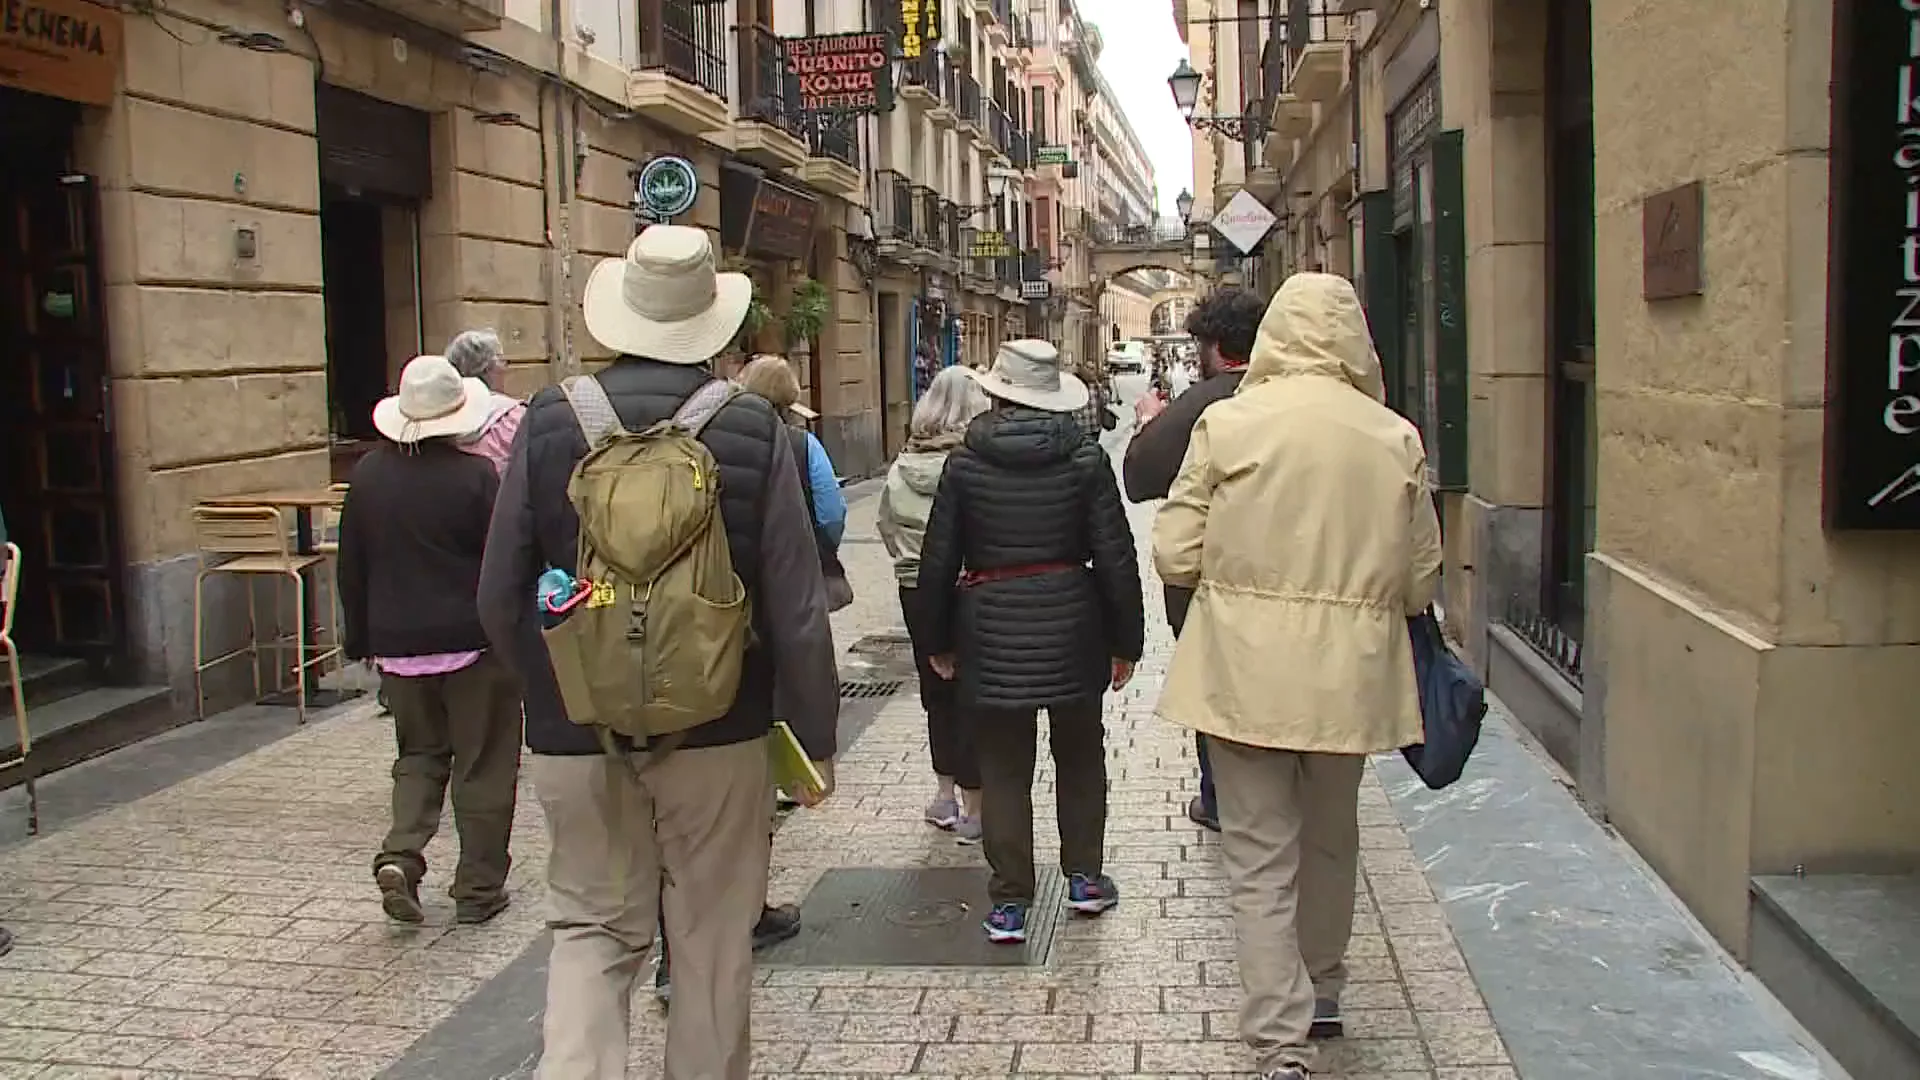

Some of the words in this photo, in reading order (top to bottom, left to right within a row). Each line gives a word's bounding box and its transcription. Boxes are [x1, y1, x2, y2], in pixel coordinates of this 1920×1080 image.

[0, 0, 104, 56] ECHENA
[786, 36, 884, 55] RESTAURANTE
[788, 53, 885, 74] JUANITO
[800, 73, 873, 94] KOJUA
[801, 94, 875, 110] JATETXEA
